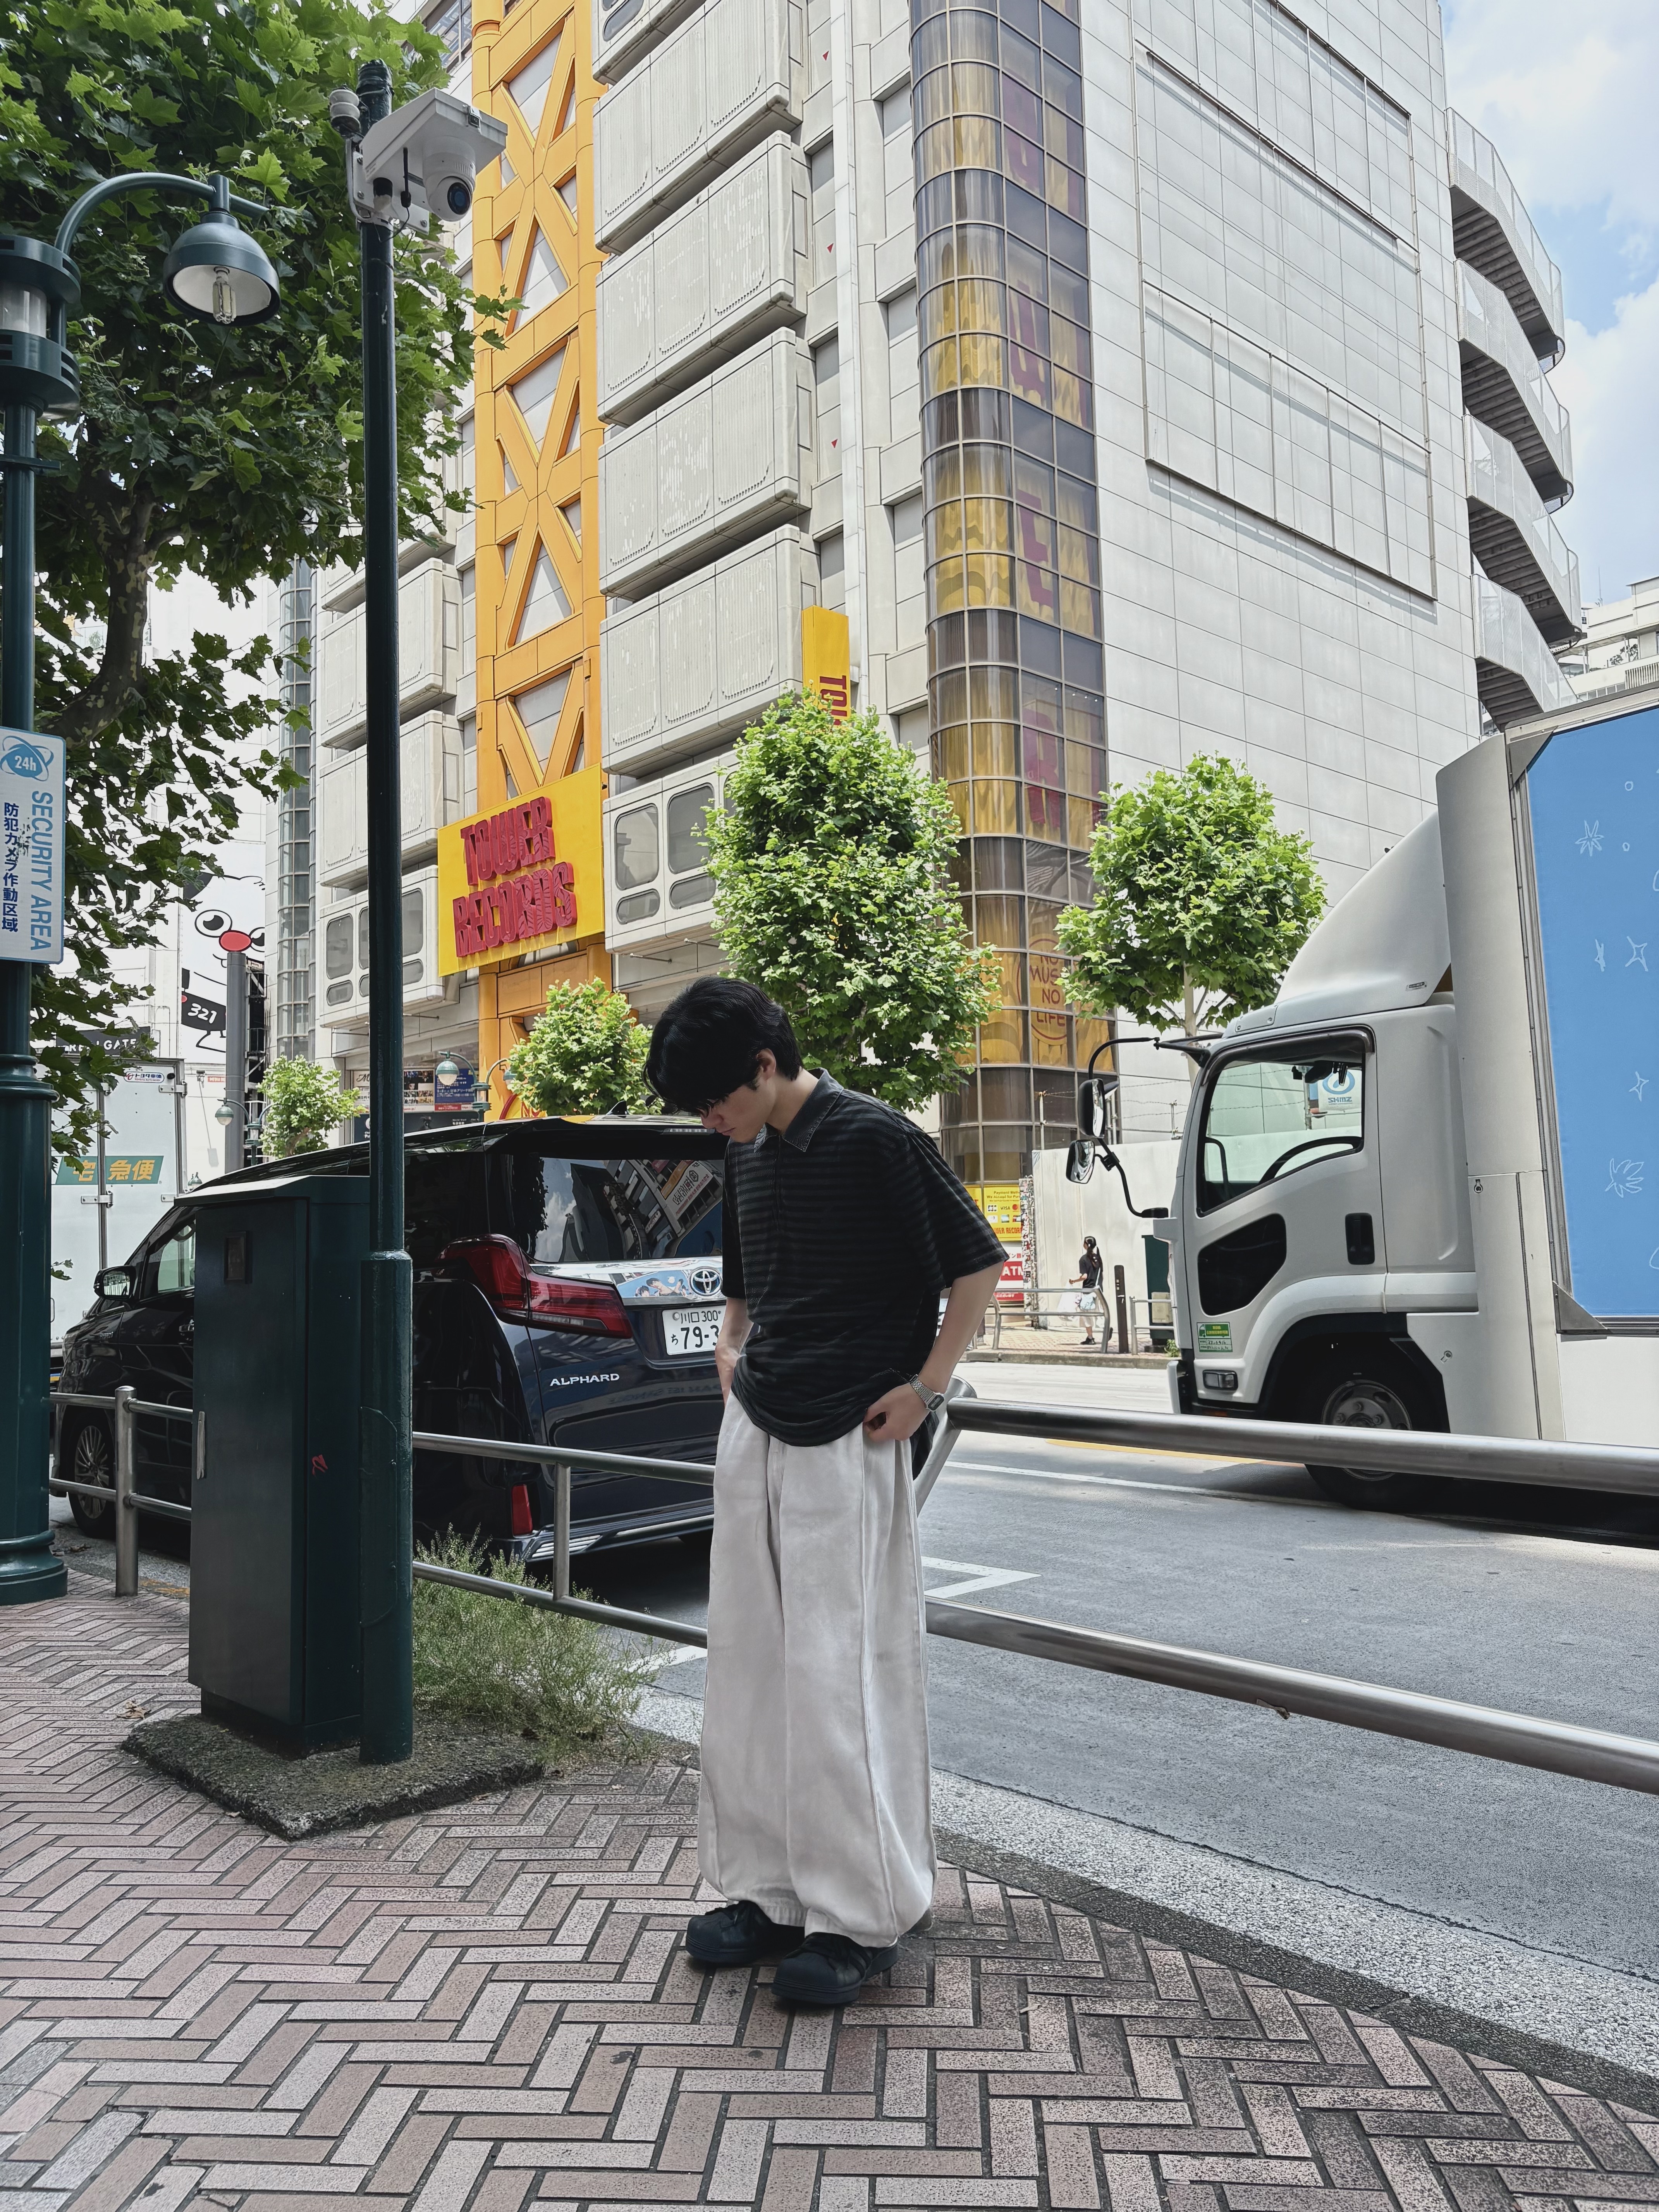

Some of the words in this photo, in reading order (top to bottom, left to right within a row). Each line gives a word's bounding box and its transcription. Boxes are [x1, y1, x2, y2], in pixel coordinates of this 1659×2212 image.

[15, 756, 36, 771] 24h
[31, 791, 53, 892] SECURITY
[460, 796, 556, 886] TOWER
[2, 802, 19, 933] 防犯カメラ作動区域
[452, 861, 577, 958] RECORDS
[30, 894, 52, 951] AREA
[1029, 964, 1059, 986] MUS
[1042, 988, 1061, 1005] NO
[187, 1003, 217, 1024] 321
[1037, 1006, 1065, 1027] LIFE
[103, 1038, 136, 1050] GATE
[73, 1159, 155, 1182] 宅急便
[681, 1312, 700, 1324] 川口
[701, 1310, 718, 1322] 300
[671, 1334, 678, 1345] ち
[681, 1324, 719, 1350] 79-3
[550, 1373, 620, 1386] ALPHARD
